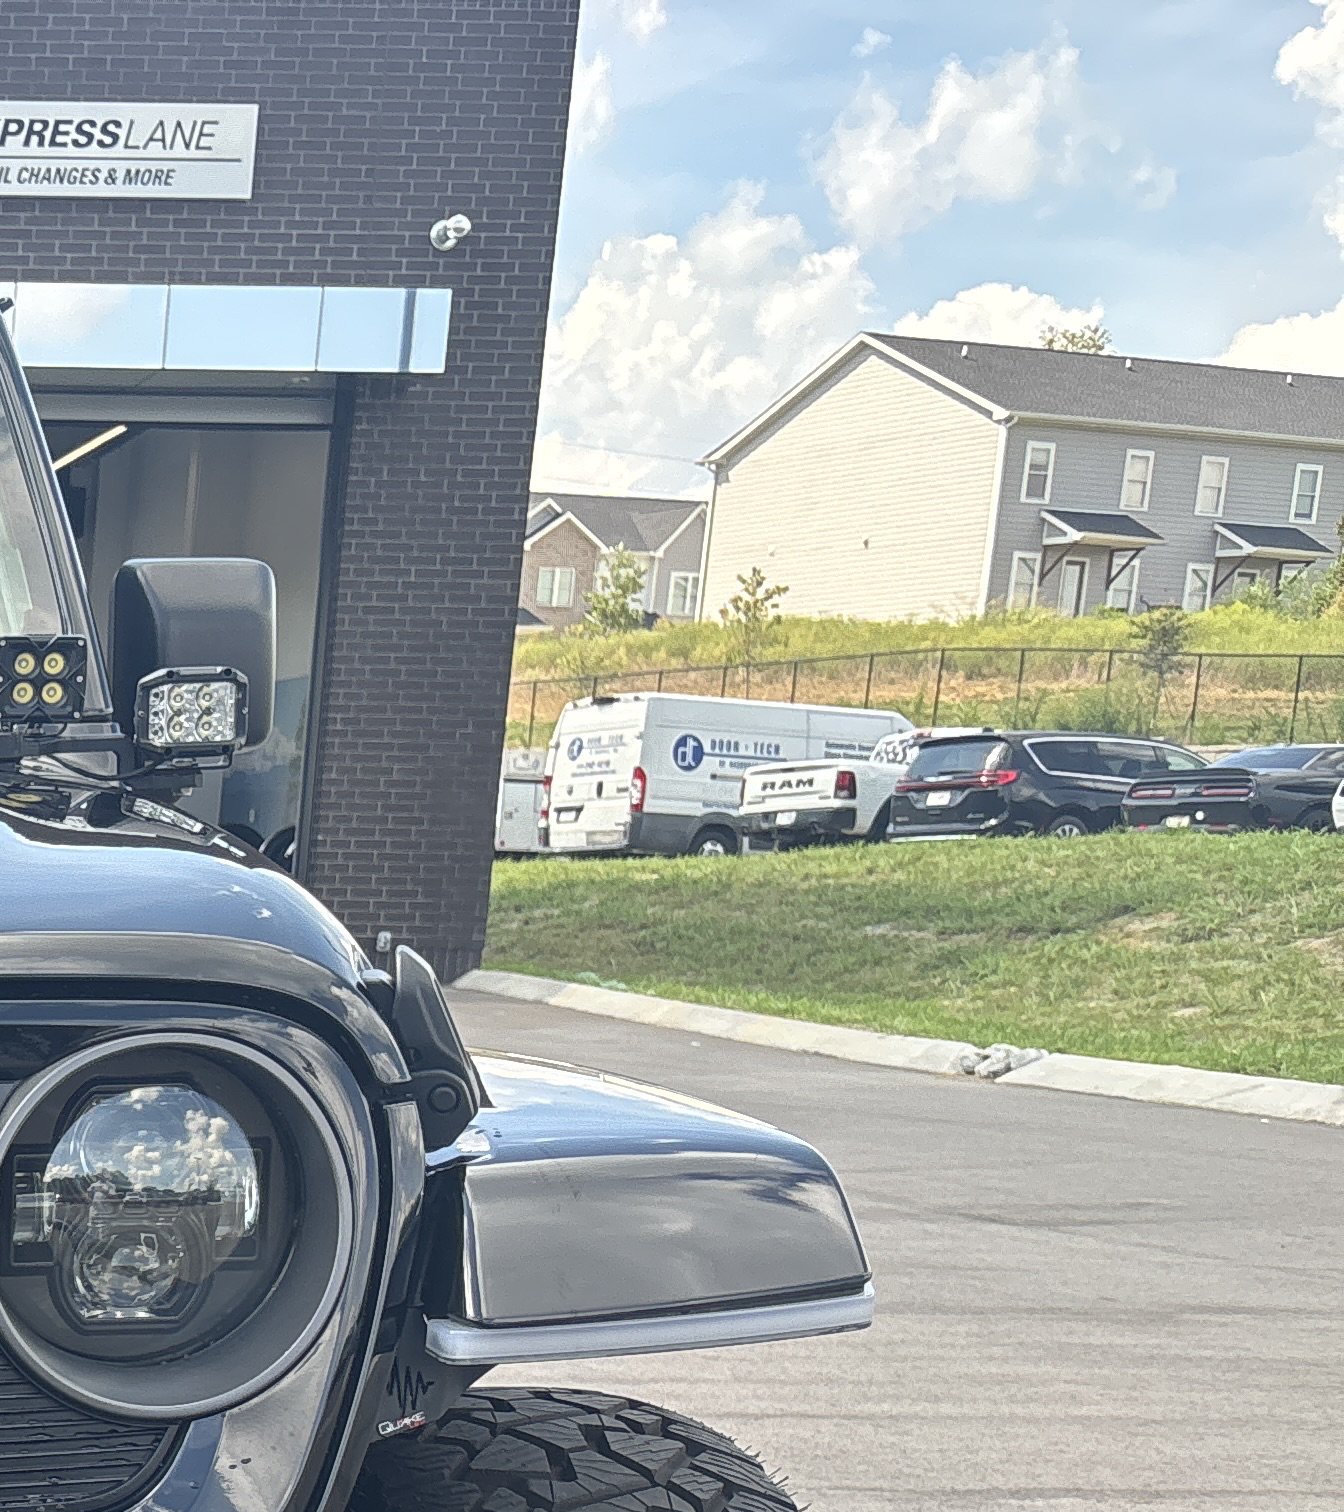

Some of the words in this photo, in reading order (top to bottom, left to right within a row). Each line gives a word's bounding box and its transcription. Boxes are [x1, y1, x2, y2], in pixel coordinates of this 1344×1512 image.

[16, 166, 103, 186] CHANGES
[103, 168, 118, 185] &
[122, 168, 176, 187] MORE
[761, 777, 815, 792] RAM
